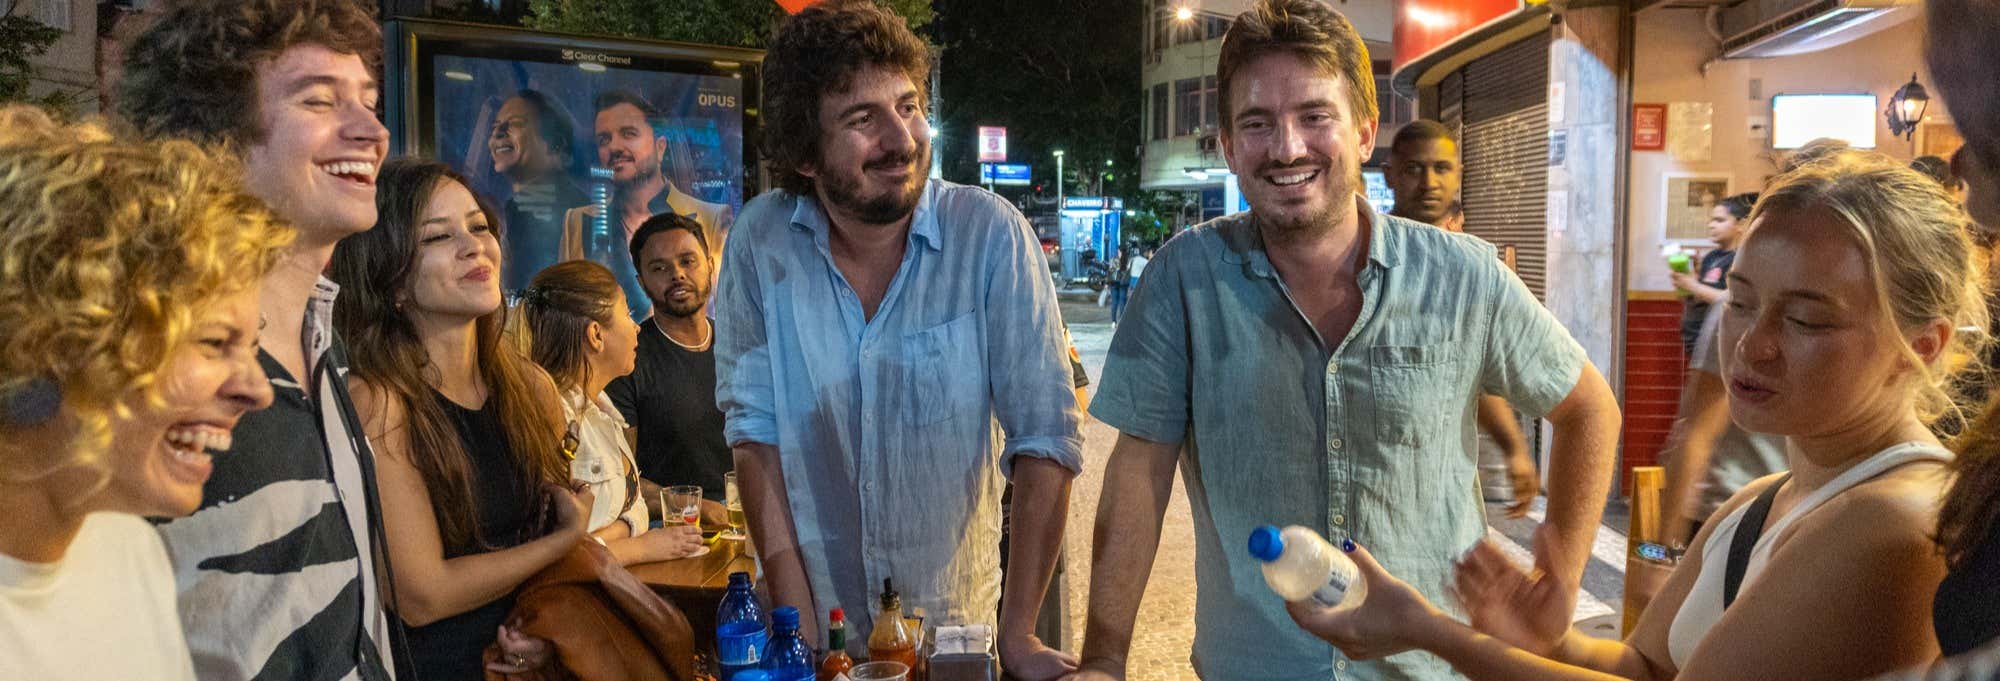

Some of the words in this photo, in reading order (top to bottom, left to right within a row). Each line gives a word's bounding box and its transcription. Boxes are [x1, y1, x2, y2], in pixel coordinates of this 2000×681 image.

[574, 51, 596, 62] Clear
[597, 53, 631, 64] Channel
[698, 94, 736, 108] OPUS
[1066, 199, 1103, 208] CHAVEIRO
